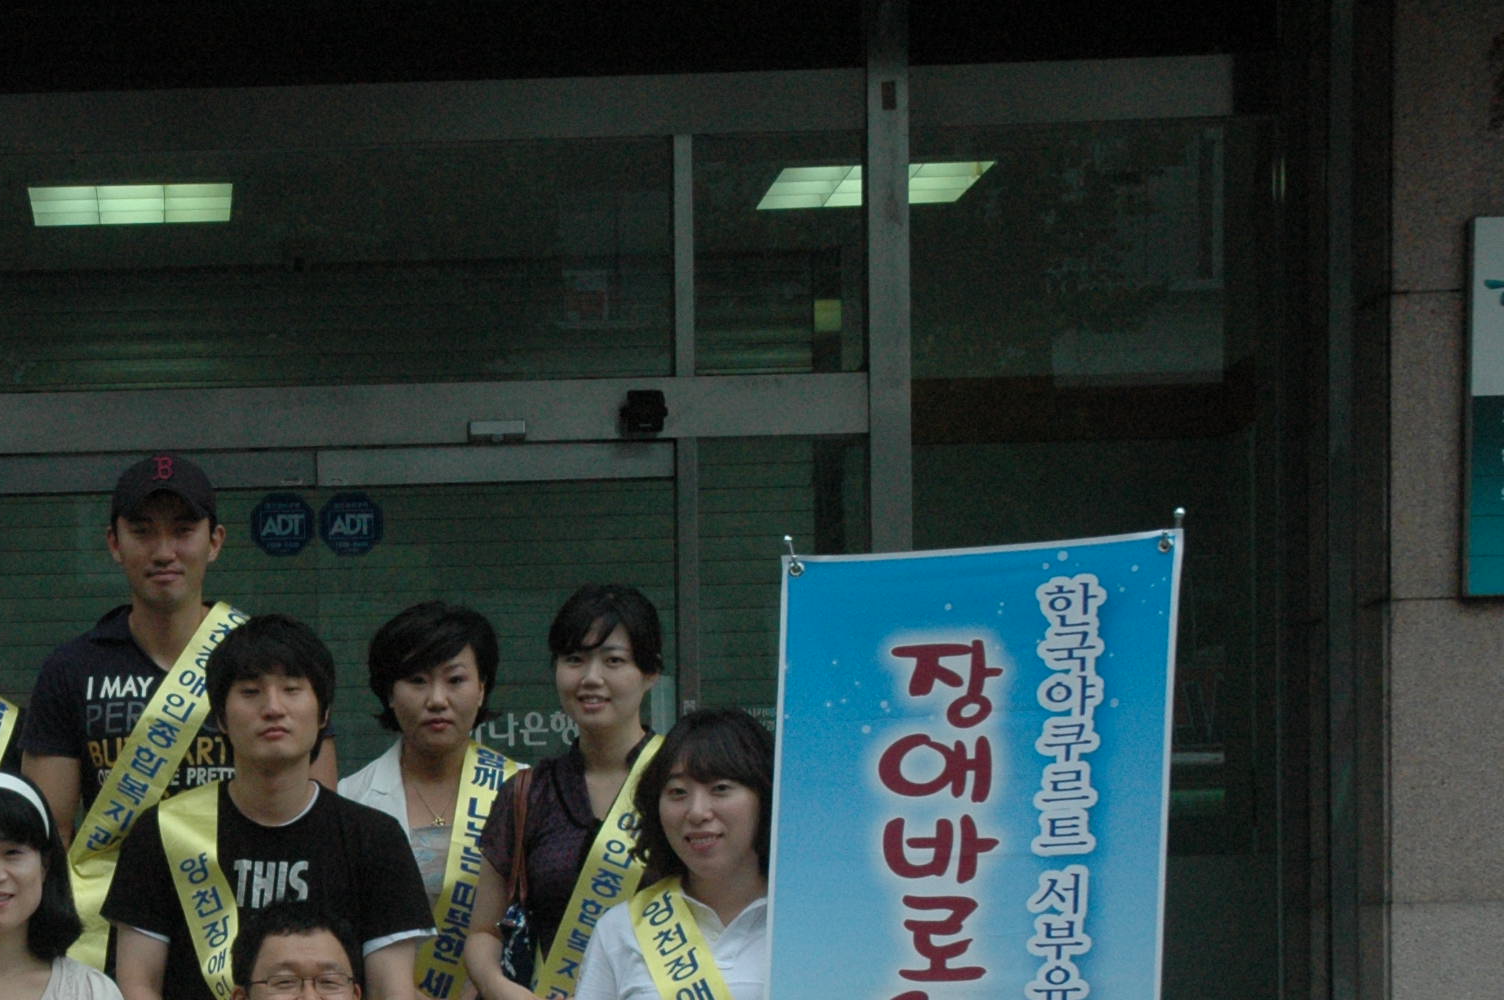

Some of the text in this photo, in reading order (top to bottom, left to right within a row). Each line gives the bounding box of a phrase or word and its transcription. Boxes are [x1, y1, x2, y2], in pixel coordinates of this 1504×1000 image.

[152, 455, 175, 480] B
[260, 513, 305, 537] ADT
[329, 513, 374, 536] ADT
[86, 674, 155, 700] I MAY
[469, 710, 580, 747] 나은행
[1038, 581, 1099, 850] 한국야쿠르트
[233, 858, 310, 909] THIS
